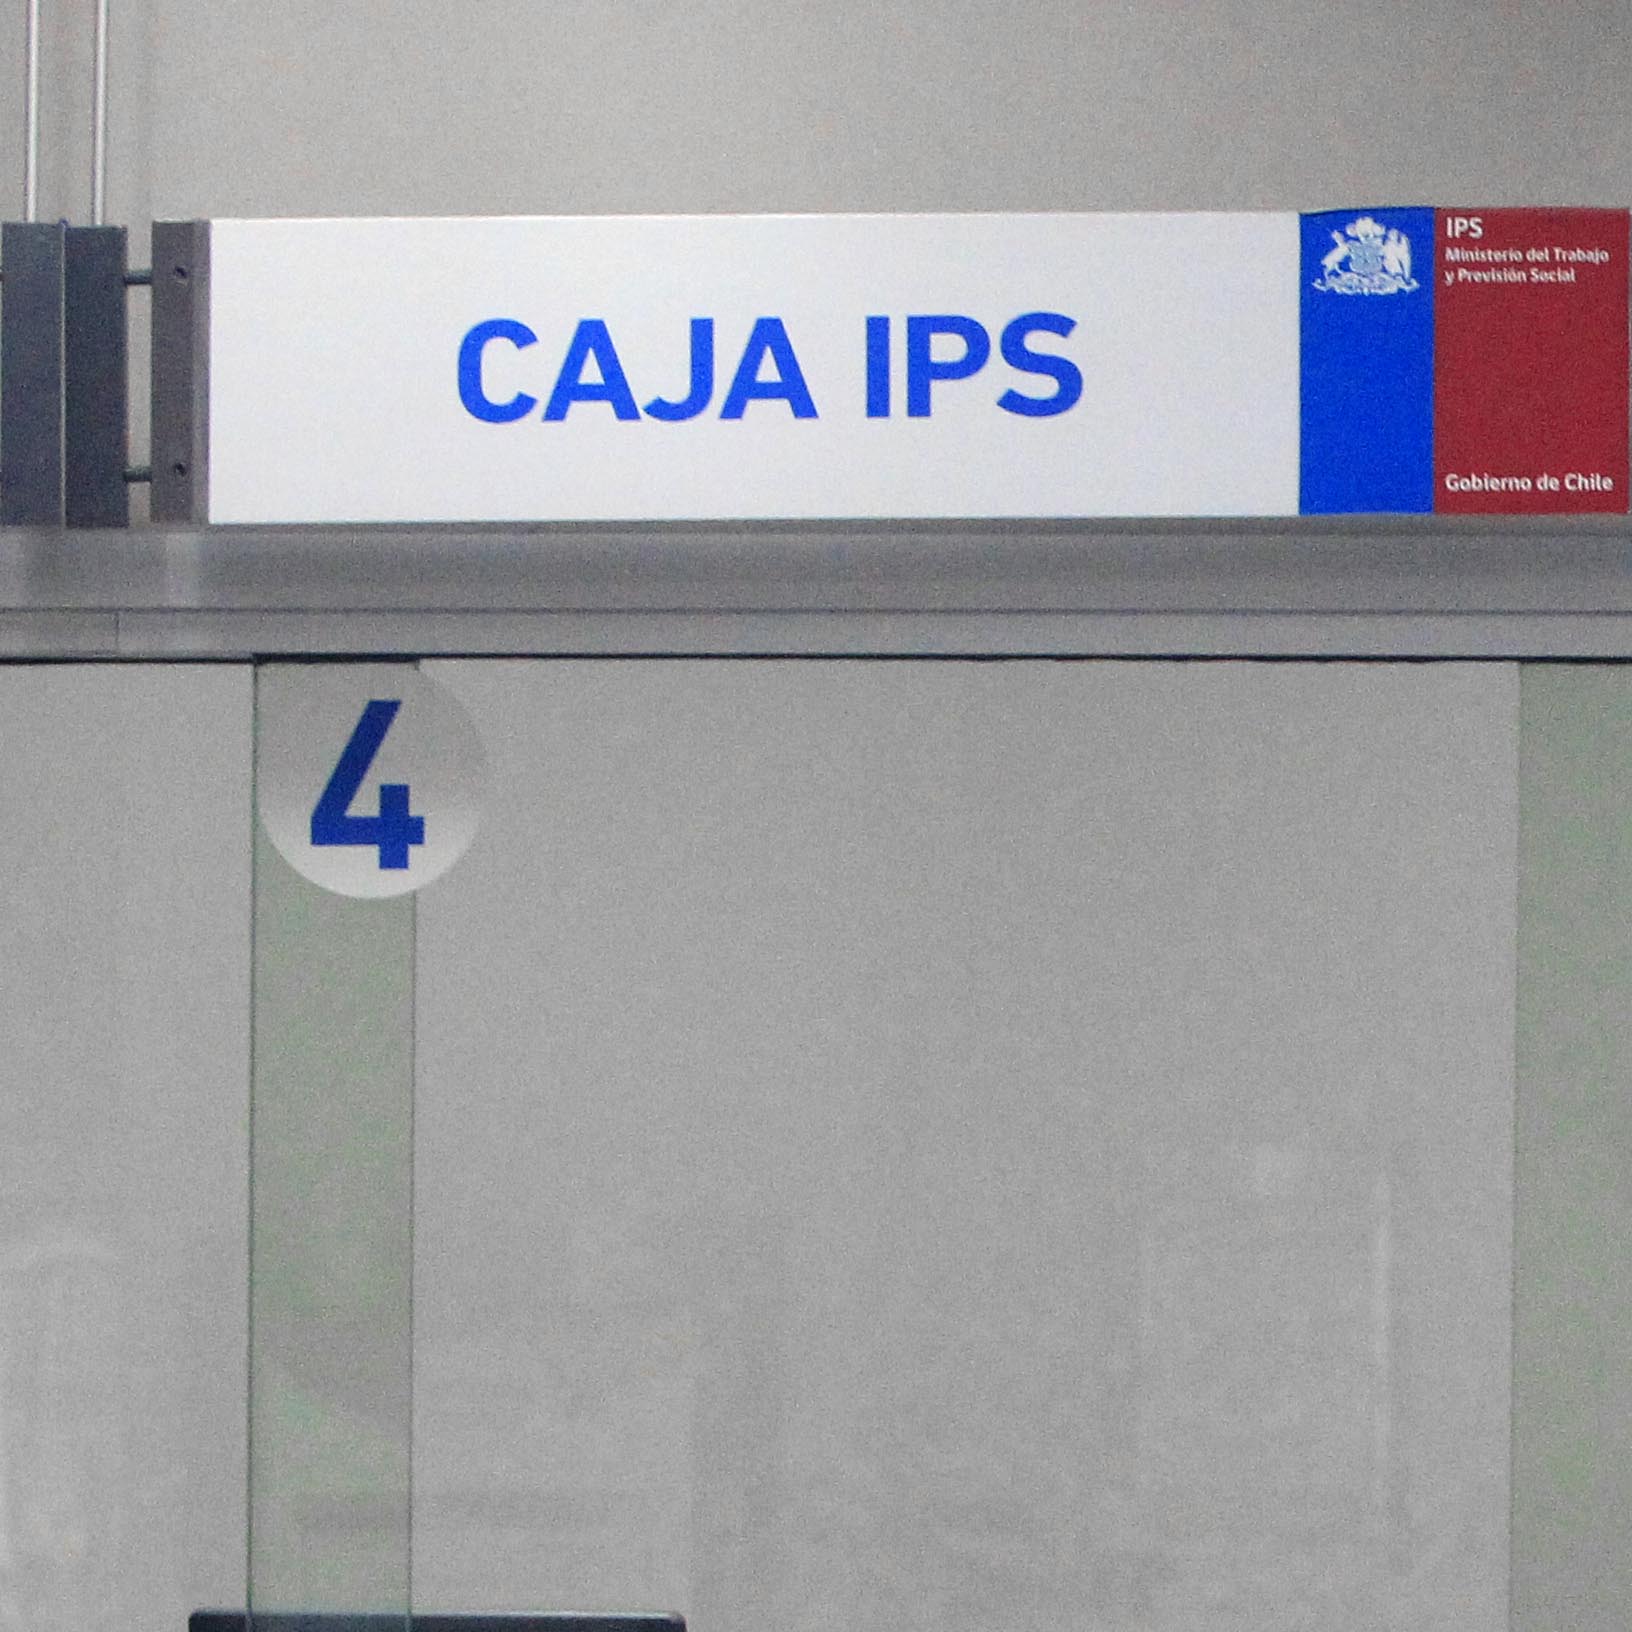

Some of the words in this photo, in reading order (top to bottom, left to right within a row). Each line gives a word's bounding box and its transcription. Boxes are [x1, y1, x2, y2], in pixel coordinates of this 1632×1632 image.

[1446, 216, 1484, 239] IPS
[1445, 247, 1523, 263] Ministerio
[1526, 247, 1549, 262] del
[1553, 247, 1609, 265] Trabajo
[1444, 269, 1454, 286] y
[1458, 267, 1527, 283] Previsión
[1530, 267, 1576, 283] Social
[458, 317, 820, 425] CAJA
[867, 312, 1084, 419] IPS
[1445, 473, 1532, 492] Gobierno
[1537, 473, 1560, 491] de
[1564, 473, 1614, 491] Chile
[310, 700, 427, 871] 4
